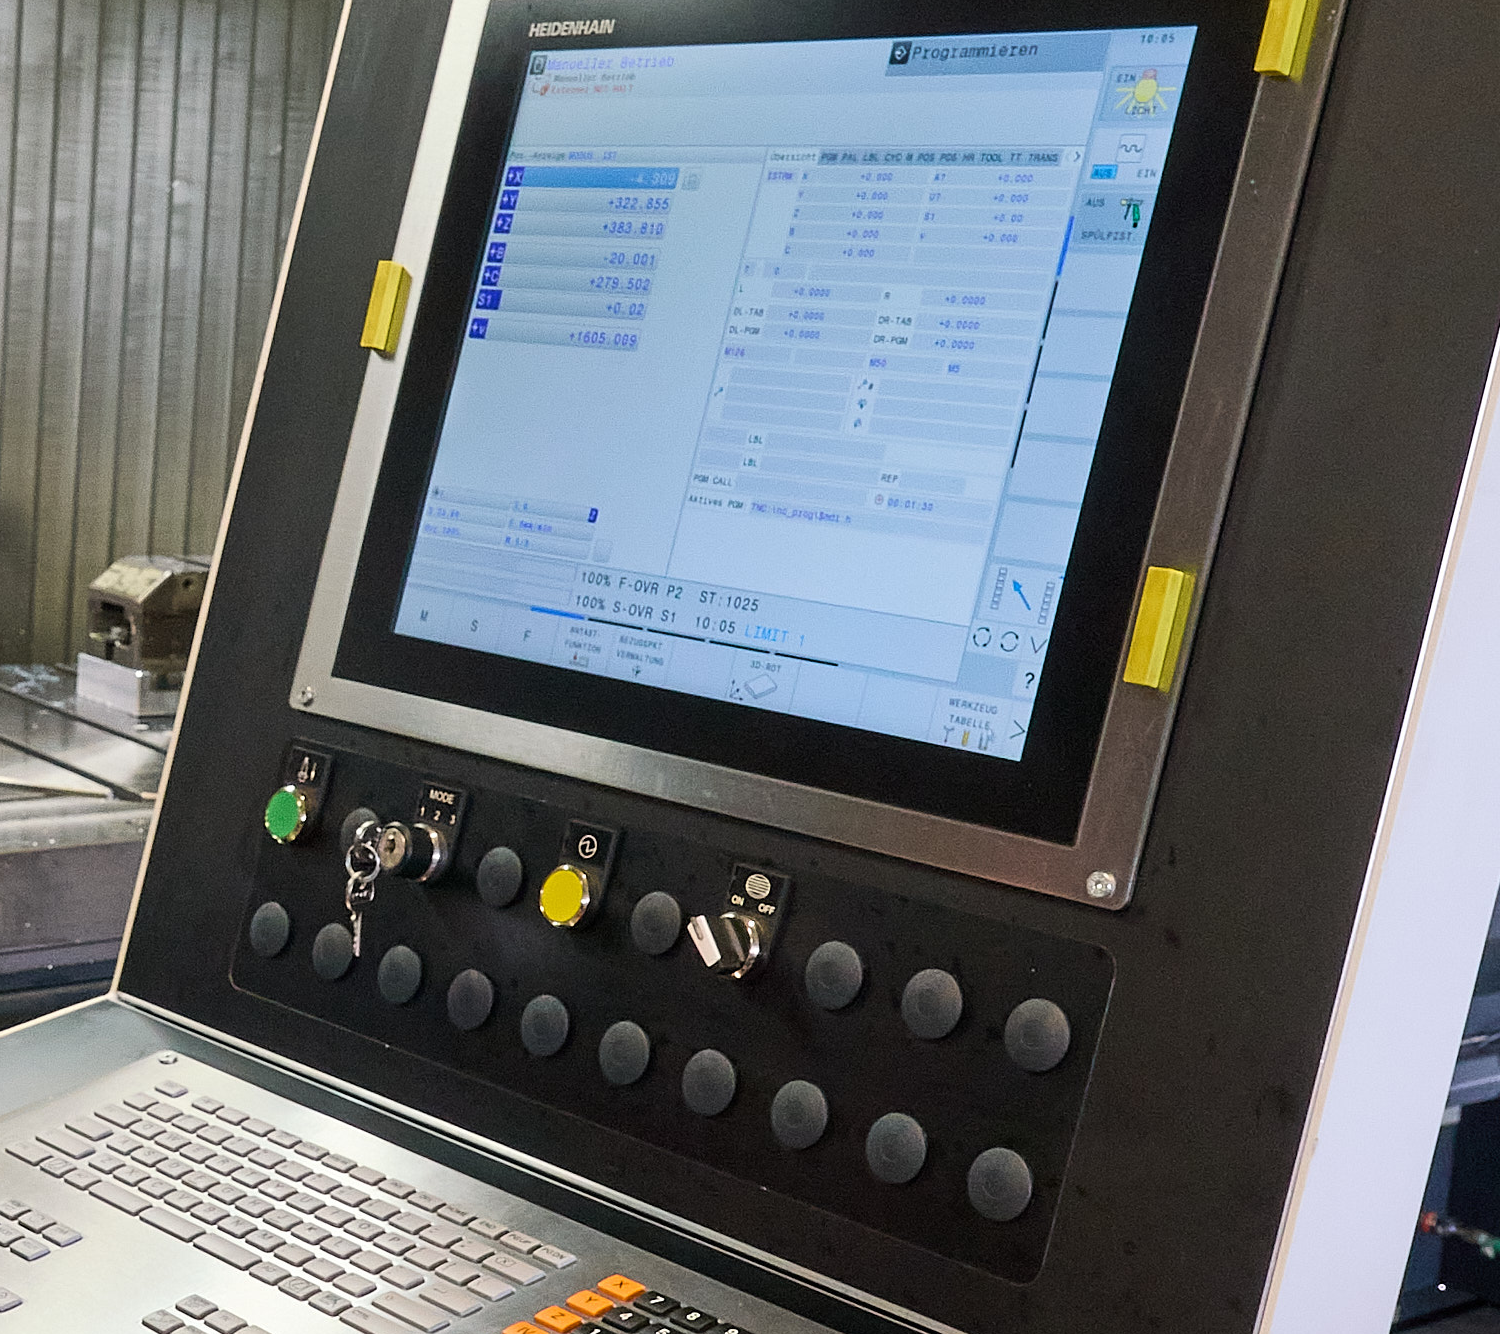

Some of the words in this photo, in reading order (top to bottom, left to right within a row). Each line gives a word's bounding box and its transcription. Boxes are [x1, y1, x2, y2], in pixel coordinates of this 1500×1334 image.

[528, 19, 615, 38] HEIDENHAIN
[1140, 33, 1176, 44] 10:05
[911, 43, 1039, 63] Programmieren
[1116, 73, 1137, 84] EIN
[1136, 168, 1157, 179] EIN
[608, 197, 670, 211] +322.855
[1085, 198, 1105, 208] AUS
[603, 221, 664, 235] +383.810
[603, 252, 656, 266] -20.001
[590, 276, 651, 291] +279.502
[478, 294, 492, 307] S1
[607, 302, 645, 316] +0.02
[878, 316, 912, 327] DR-TAB
[581, 570, 611, 588] 100%
[618, 576, 659, 596] F-OVR
[666, 584, 684, 599] P2
[700, 590, 760, 612] ST:1025
[575, 594, 606, 611] 100%
[612, 600, 653, 621] S-OVR
[660, 608, 677, 624] S1
[696, 615, 737, 635] 10:05
[744, 623, 790, 643] LIMIT
[470, 619, 479, 633] S
[523, 629, 531, 643] F
[949, 697, 998, 715] WERKZEUG
[429, 789, 455, 805] MODE
[420, 806, 426, 817] 1
[434, 810, 442, 821] 2
[450, 814, 456, 825] 3
[731, 894, 745, 906] ON
[757, 902, 776, 915] OFF
[614, 1280, 629, 1289] X
[585, 1296, 598, 1304] Y
[650, 1295, 665, 1305] 7
[551, 1312, 565, 1320] Z
[619, 1311, 634, 1321] 4
[686, 1311, 701, 1321] 8
